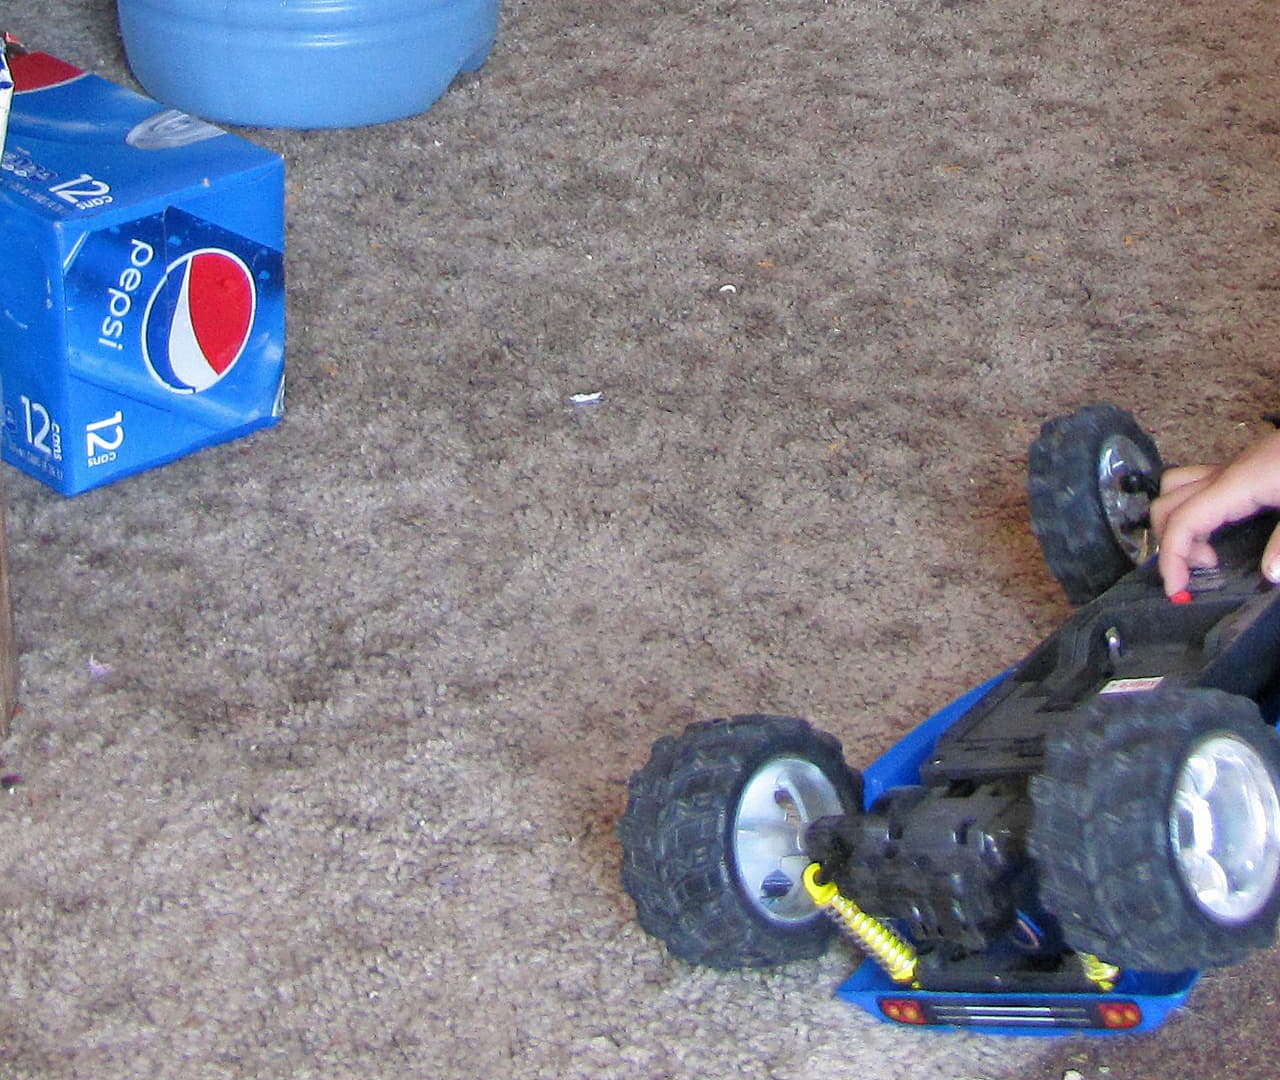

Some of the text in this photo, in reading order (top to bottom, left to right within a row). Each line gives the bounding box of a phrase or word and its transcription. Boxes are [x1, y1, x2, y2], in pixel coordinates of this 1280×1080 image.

[48, 173, 111, 204] 12
[75, 195, 113, 210] cans
[98, 238, 154, 351] pepsi
[20, 394, 53, 455] 12
[86, 410, 125, 457] 12
[87, 451, 118, 468] cans
